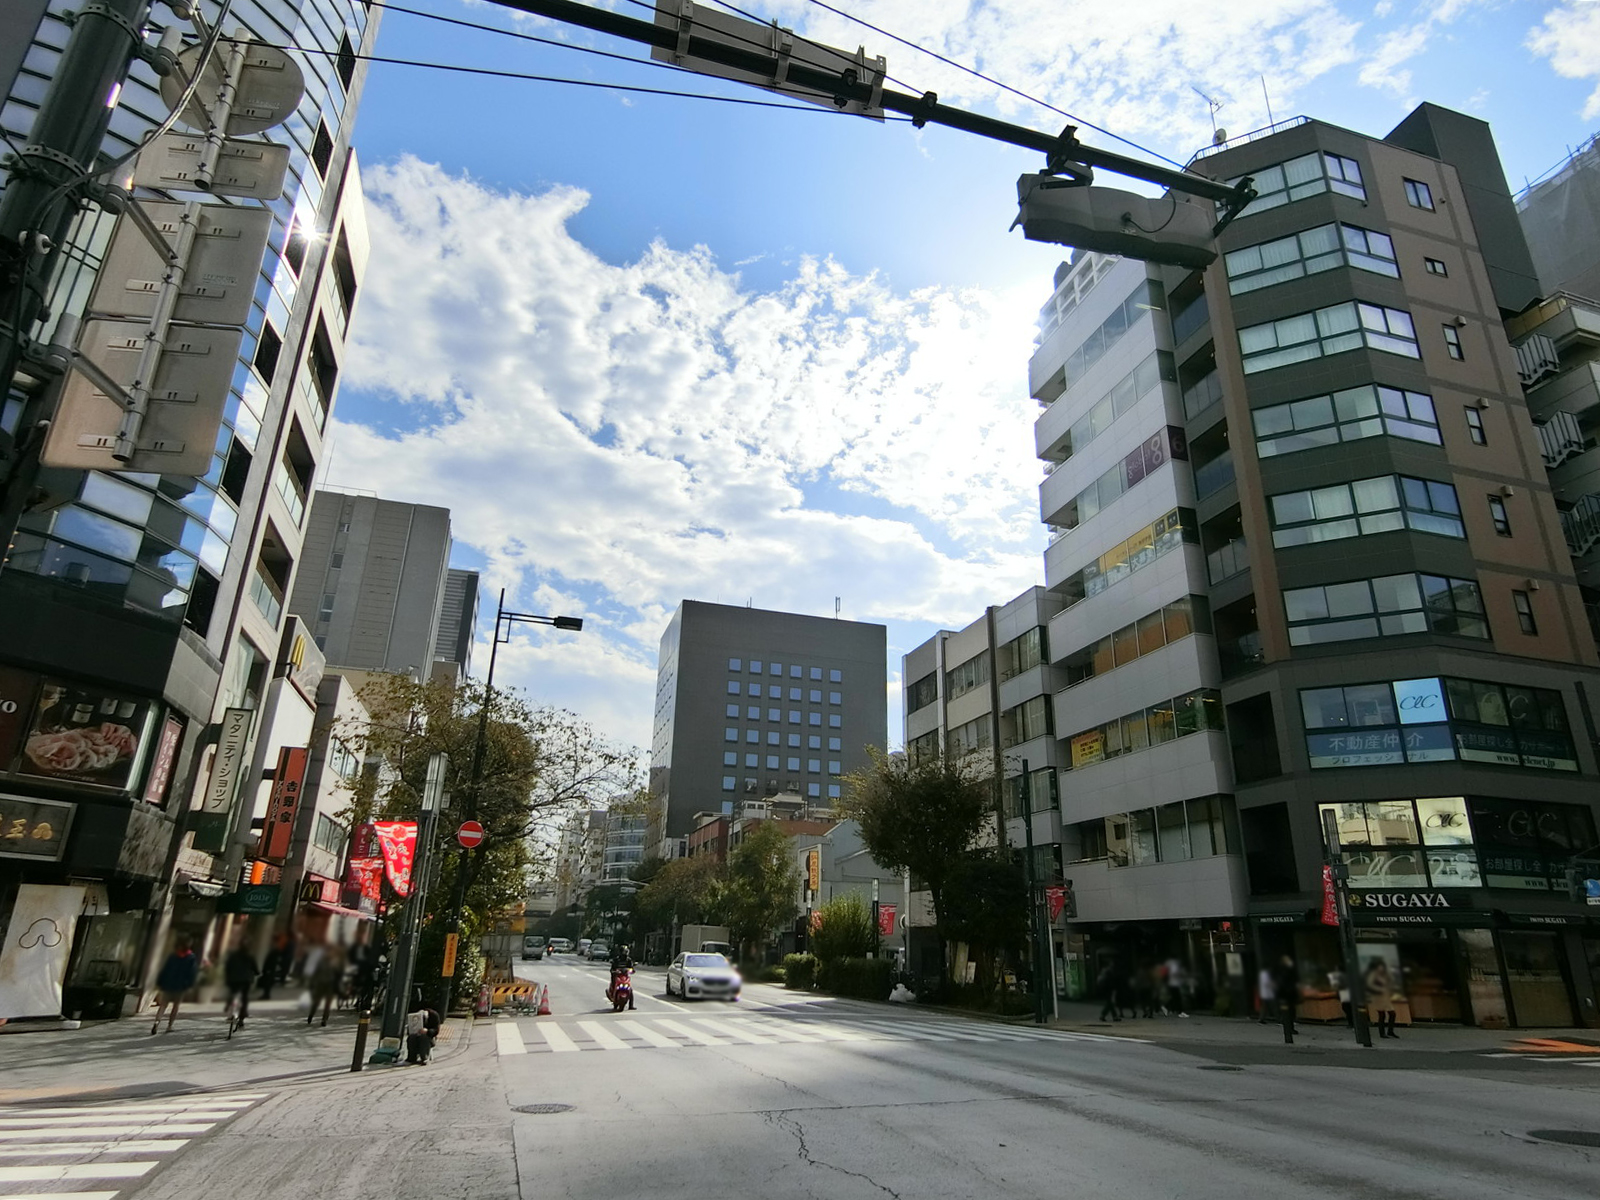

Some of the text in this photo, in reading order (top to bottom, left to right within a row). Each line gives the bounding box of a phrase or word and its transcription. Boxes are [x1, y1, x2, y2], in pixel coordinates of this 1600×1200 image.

[1329, 732, 1424, 752] 不動産仲介
[211, 713, 244, 809] マタニティ・ショップ
[1332, 753, 1428, 765] プロフェッシナル
[280, 780, 299, 824] 吉野家
[1365, 893, 1450, 908] SUGAYA
